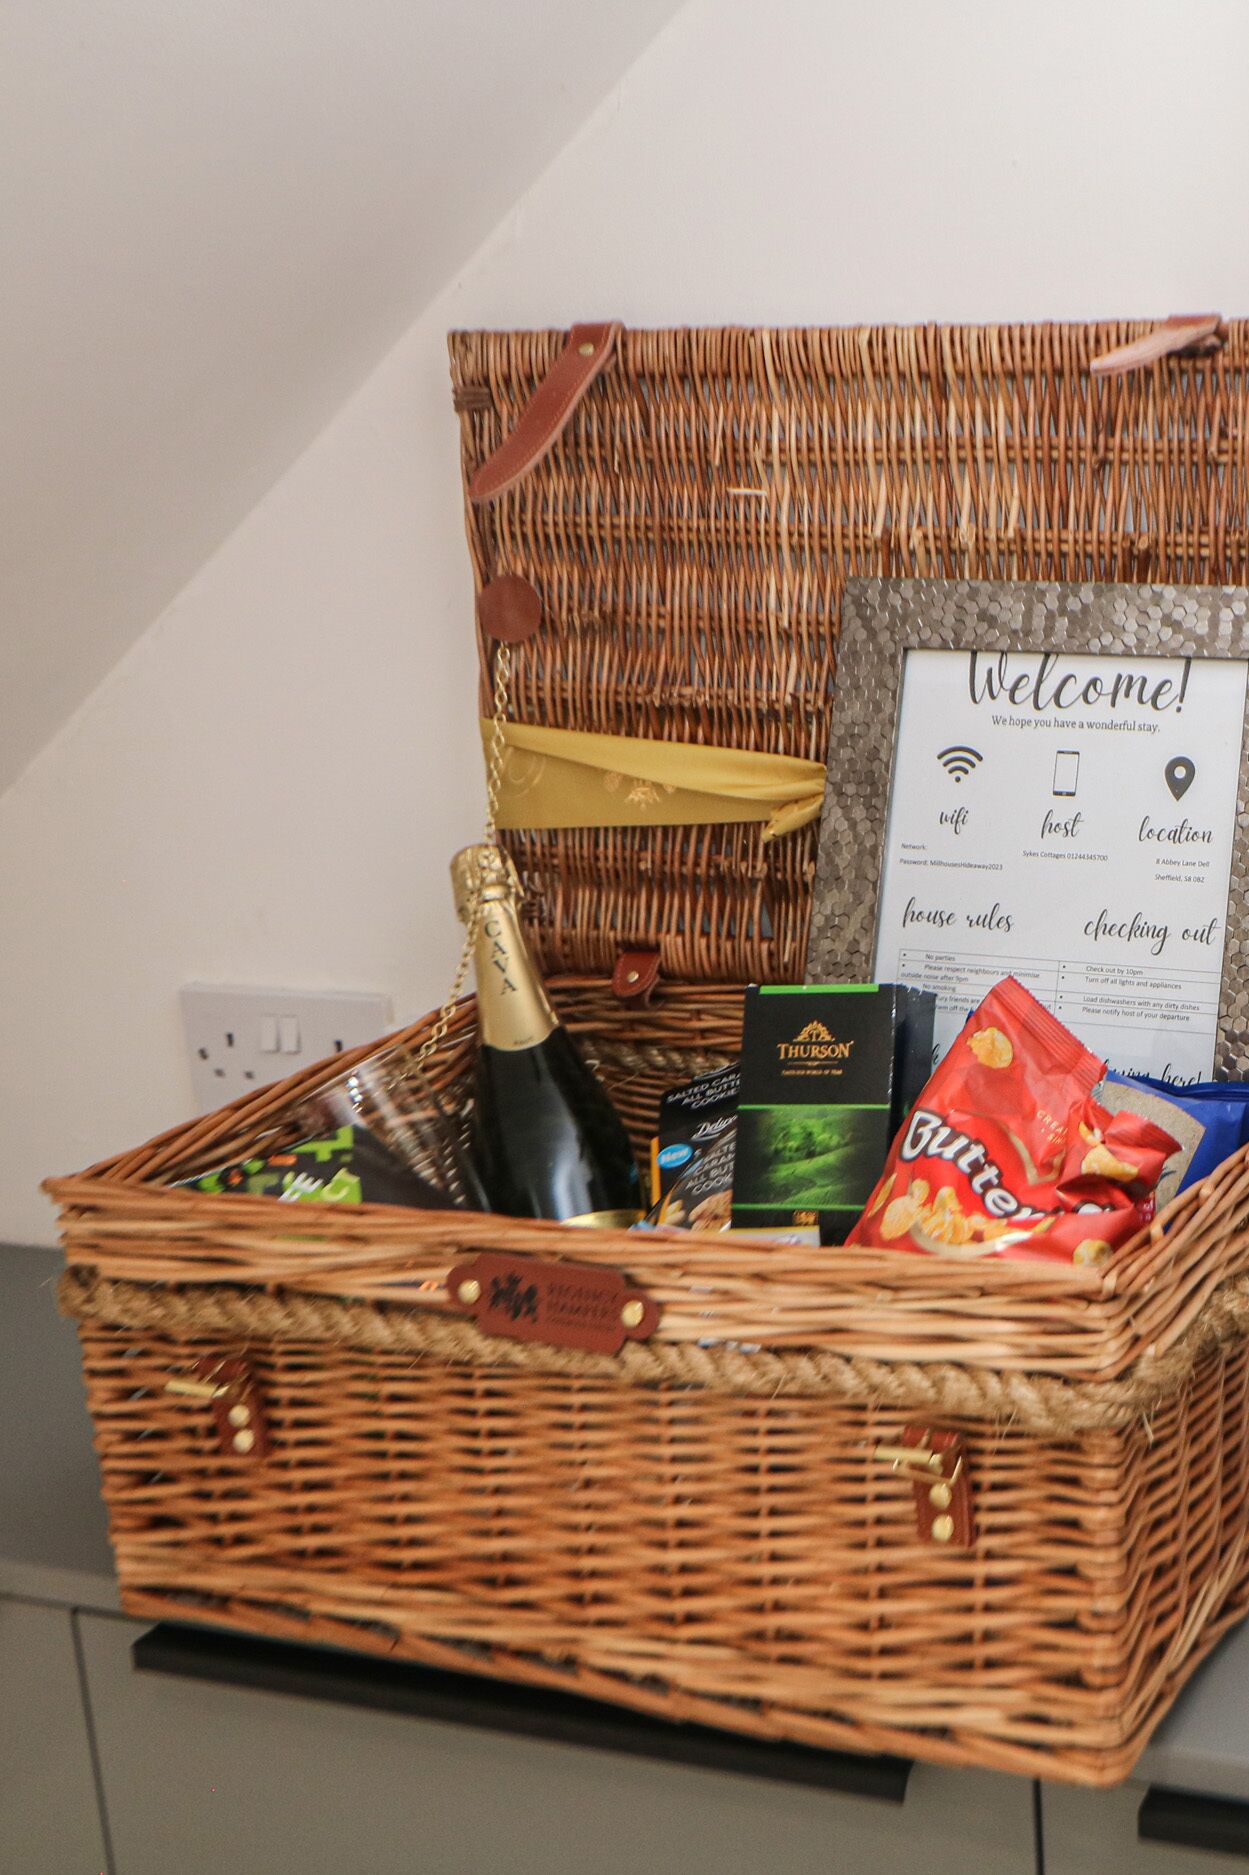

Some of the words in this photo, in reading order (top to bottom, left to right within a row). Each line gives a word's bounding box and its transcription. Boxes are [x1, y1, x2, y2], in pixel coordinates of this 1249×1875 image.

[968, 651, 1192, 713] Welcome!
[991, 715, 1008, 726] We
[1008, 715, 1032, 729] hope
[1033, 719, 1051, 729] you
[1053, 717, 1077, 729] have
[1078, 721, 1084, 729] a
[1086, 719, 1136, 731] wonderful
[1137, 722, 1161, 735] stay.
[939, 807, 969, 835] wifi
[1040, 809, 1084, 840] host
[1138, 815, 1214, 845] location
[1022, 850, 1040, 859] Sykes
[1040, 851, 1066, 861] Cottages
[1161, 858, 1181, 868] Abbey
[1181, 860, 1197, 868] Lane
[902, 896, 956, 928] house
[966, 902, 1015, 933] rules
[1084, 908, 1172, 956] checking
[1181, 918, 1222, 945] out
[484, 919, 517, 996] CAVA
[925, 953, 934, 961] No
[935, 954, 956, 963] parties
[900, 971, 922, 980] outside
[923, 973, 940, 981] noise
[940, 974, 955, 982] after
[924, 964, 943, 972] Please
[944, 965, 967, 974] respect
[966, 966, 1000, 976] neighbours
[1000, 968, 1013, 977] and
[1013, 970, 1040, 979] minimise
[1086, 965, 1105, 973] Check
[1117, 968, 1125, 976] by
[1125, 968, 1144, 977] 10pm
[933, 984, 957, 993] smoking
[1085, 976, 1100, 984] Turn
[1100, 977, 1110, 985] off
[1118, 978, 1135, 987] lights
[1149, 981, 1182, 990] appliances
[1083, 995, 1098, 1003] Load
[1098, 996, 1137, 1006] dishwashers
[1137, 999, 1151, 1007] with
[1152, 1001, 1164, 1010] any
[1164, 1001, 1179, 1011] dirty
[1180, 1002, 1200, 1011] dishes
[1082, 1006, 1101, 1014] Please
[1102, 1007, 1121, 1017] notify
[1121, 1009, 1136, 1017] host
[1136, 1010, 1144, 1018] of
[1144, 1011, 1159, 1020] your
[1159, 1012, 1190, 1022] departure
[776, 1040, 855, 1060] THURSON
